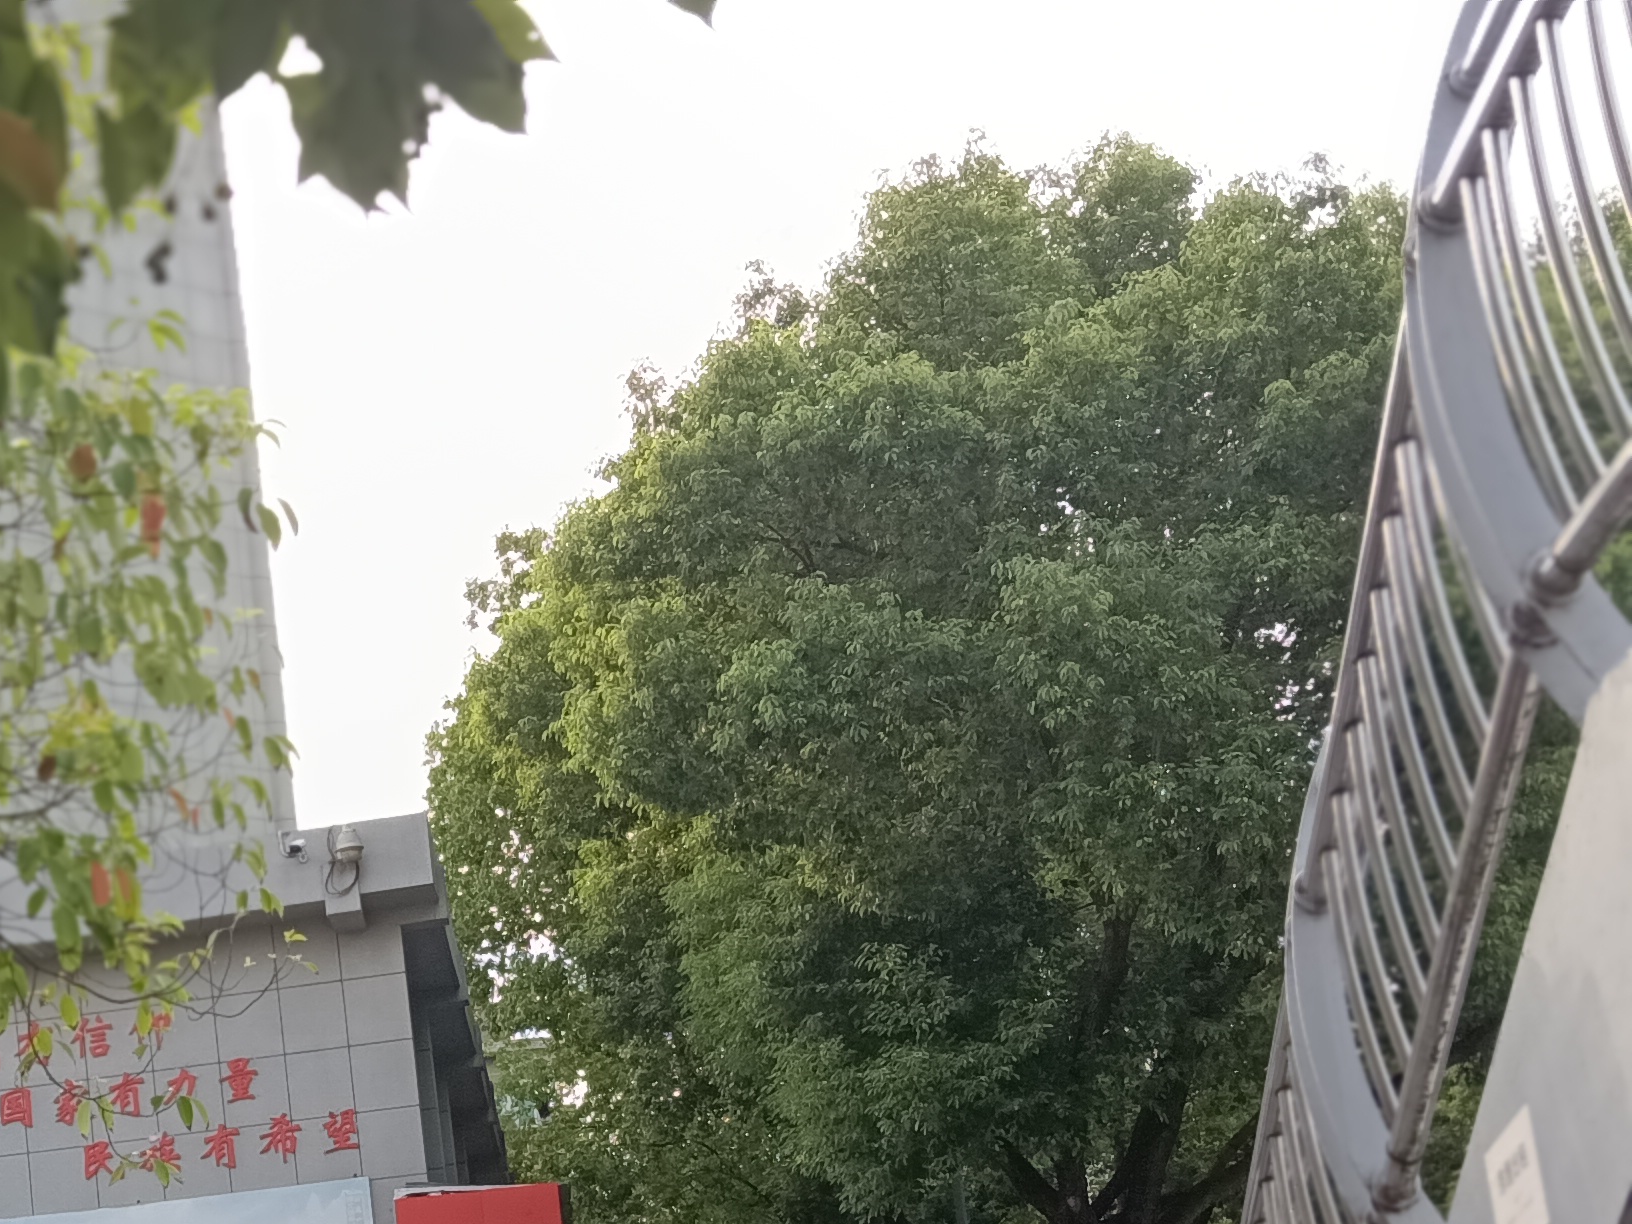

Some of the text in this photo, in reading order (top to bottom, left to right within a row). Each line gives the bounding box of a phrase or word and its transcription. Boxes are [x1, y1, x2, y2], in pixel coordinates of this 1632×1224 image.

[0, 1058, 258, 1128] 国家有力量
[83, 1109, 360, 1180] 民族有希望
